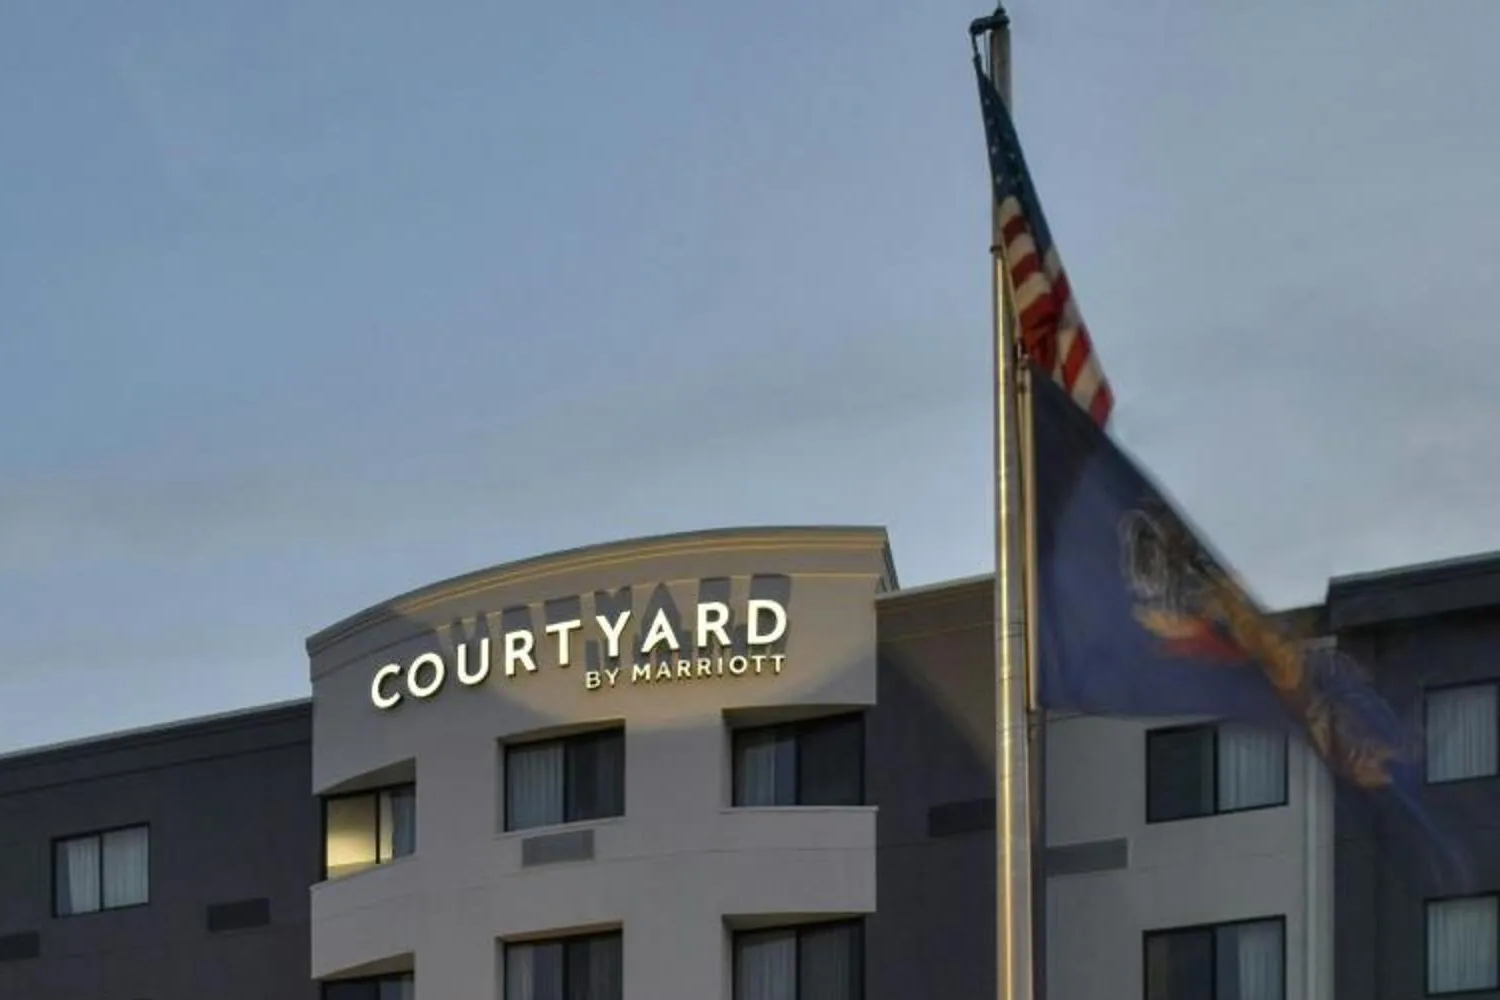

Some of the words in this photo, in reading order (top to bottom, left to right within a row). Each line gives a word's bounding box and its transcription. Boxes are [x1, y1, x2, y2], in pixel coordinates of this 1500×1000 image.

[371, 599, 788, 709] COURTYARD
[585, 670, 619, 689] BY
[632, 655, 786, 681] MARRIOTT
